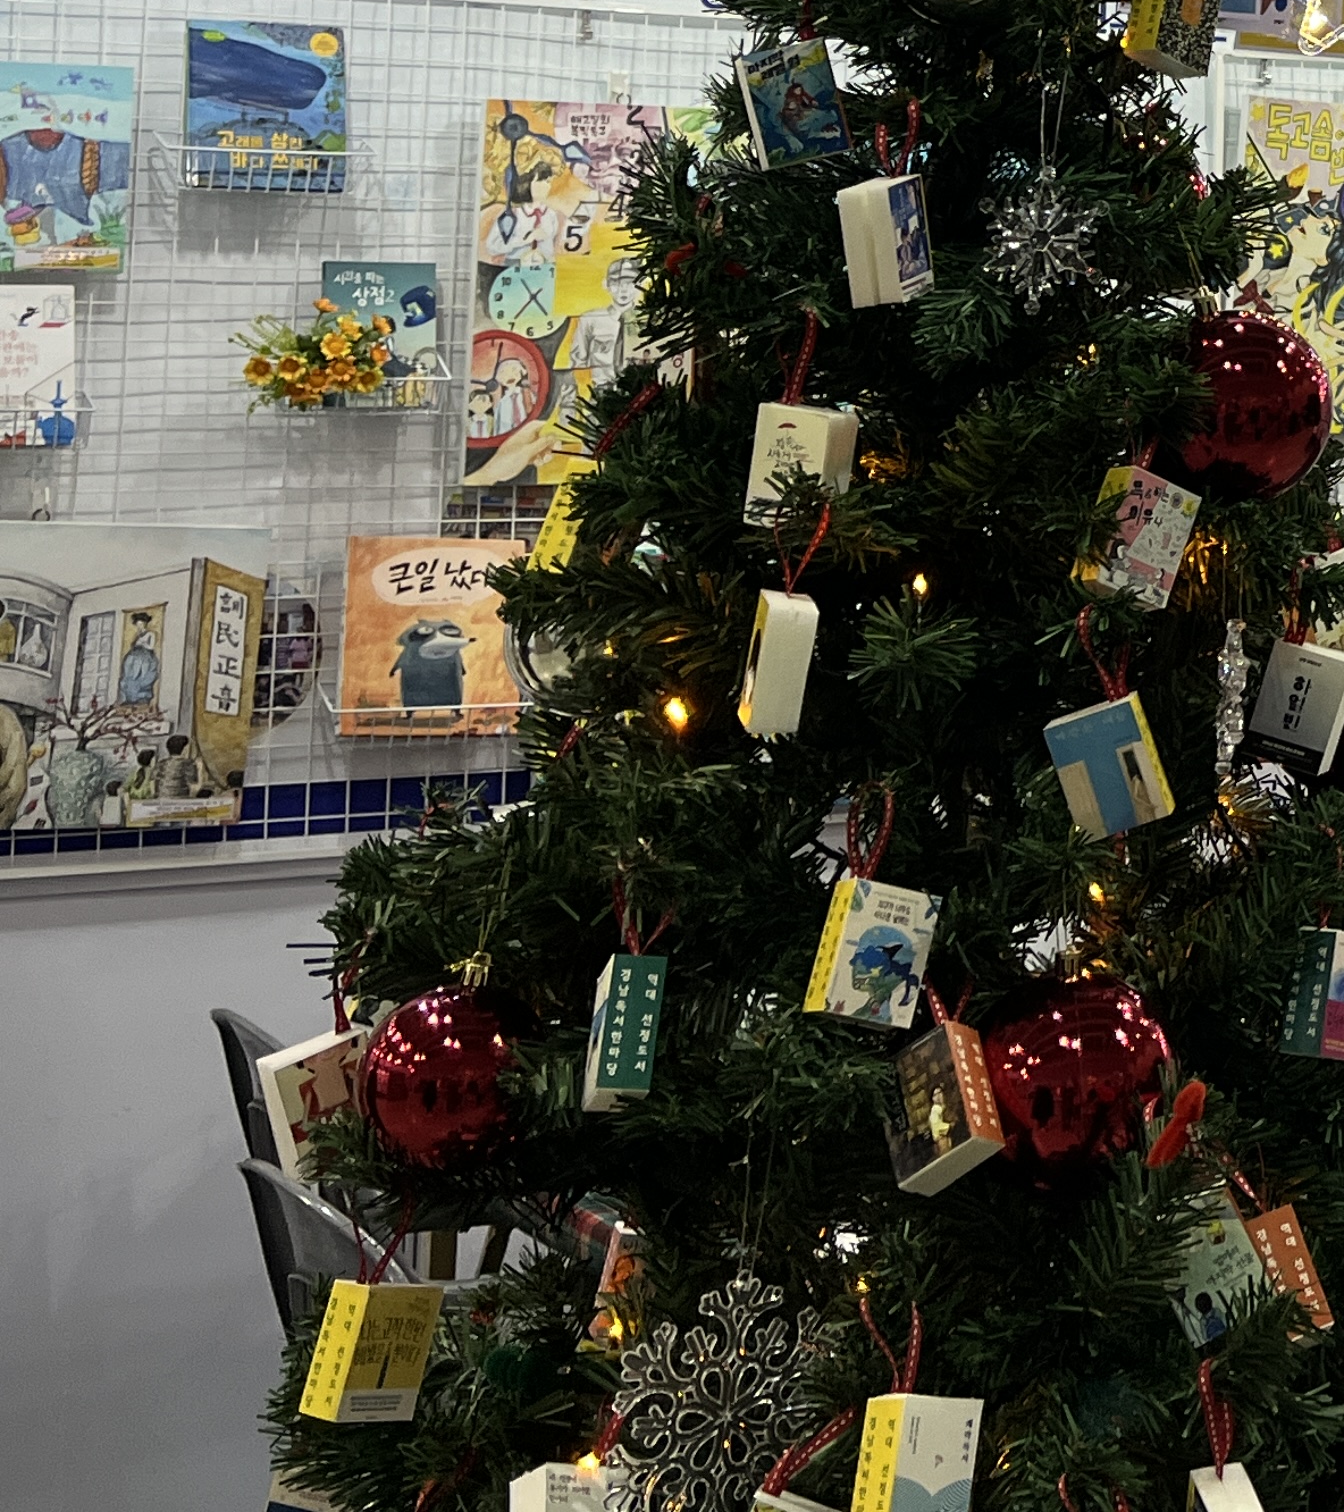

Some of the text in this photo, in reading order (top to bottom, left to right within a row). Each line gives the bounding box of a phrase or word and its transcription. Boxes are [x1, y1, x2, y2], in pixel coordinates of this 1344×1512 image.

[564, 226, 583, 252] 5
[389, 558, 440, 596] 큰일
[211, 591, 246, 712] 訓民正音
[605, 968, 632, 1078] 경남독서한마당
[634, 1012, 653, 1074] 선정도서
